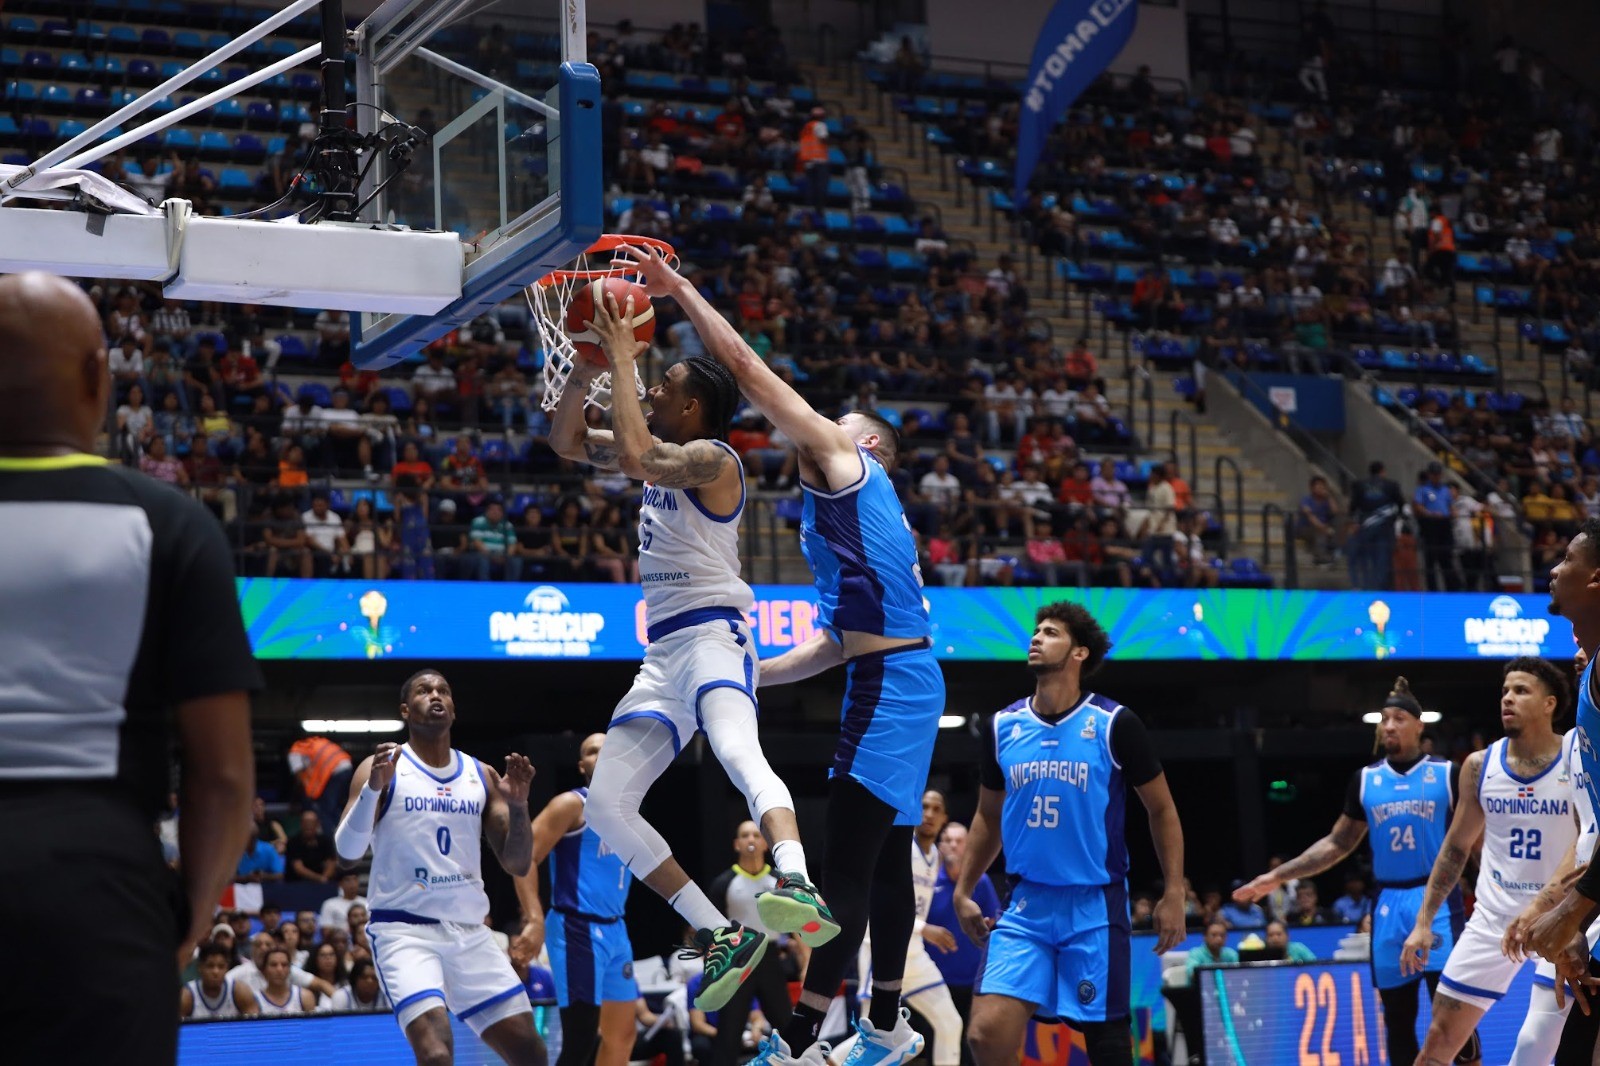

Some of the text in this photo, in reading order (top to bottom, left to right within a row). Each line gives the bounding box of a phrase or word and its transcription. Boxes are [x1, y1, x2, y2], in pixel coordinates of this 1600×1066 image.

[1010, 760, 1089, 793] NICARAGUA
[405, 796, 480, 816] DOMINICANA
[1026, 795, 1060, 828] 35
[1371, 799, 1436, 827] NICARAGUA
[1486, 798, 1569, 815] DOMINICANA
[436, 826, 451, 856] 0
[1389, 825, 1416, 851] 24
[1509, 828, 1542, 860] 22
[1294, 972, 1340, 1066] 22
